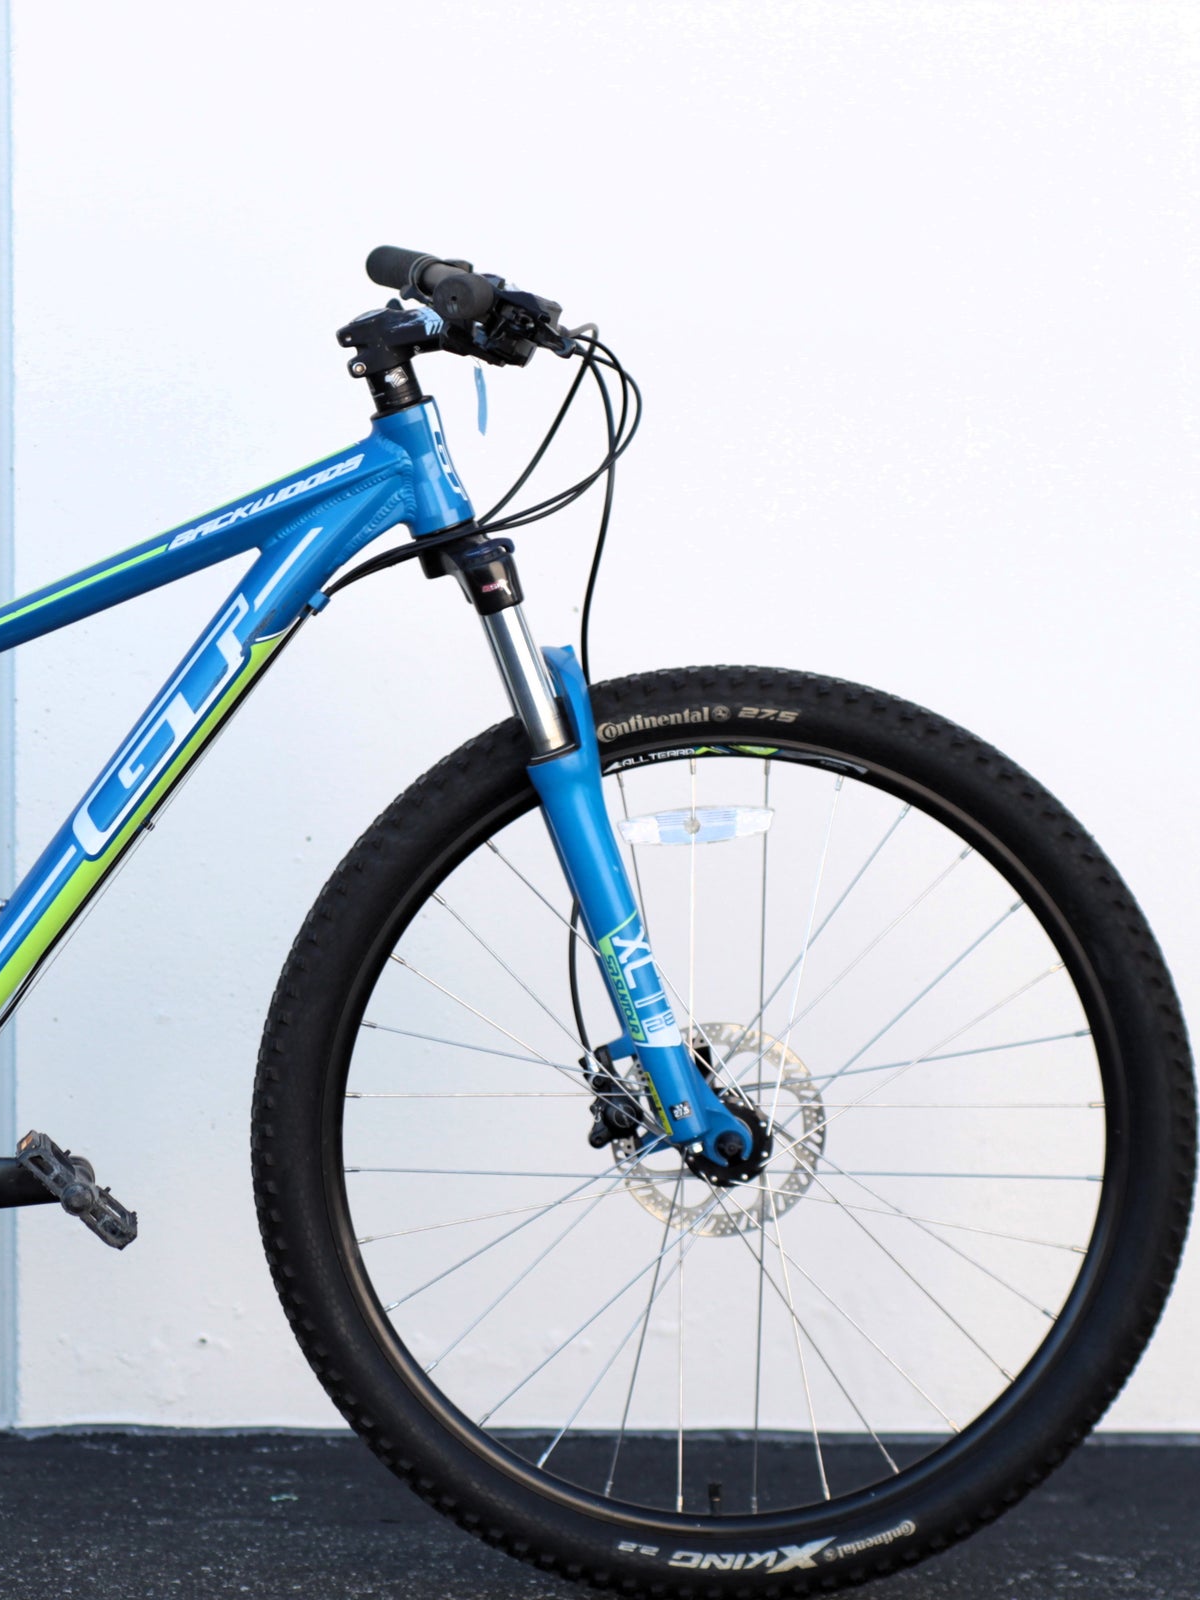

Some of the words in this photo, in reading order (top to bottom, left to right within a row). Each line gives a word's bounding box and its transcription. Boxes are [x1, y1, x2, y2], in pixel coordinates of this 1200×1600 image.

[167, 453, 365, 550] BACKWOODS
[72, 592, 249, 857] GT
[597, 706, 709, 743] Continental
[738, 706, 799, 723] 27.5
[615, 979, 641, 1034] SUNTOUR
